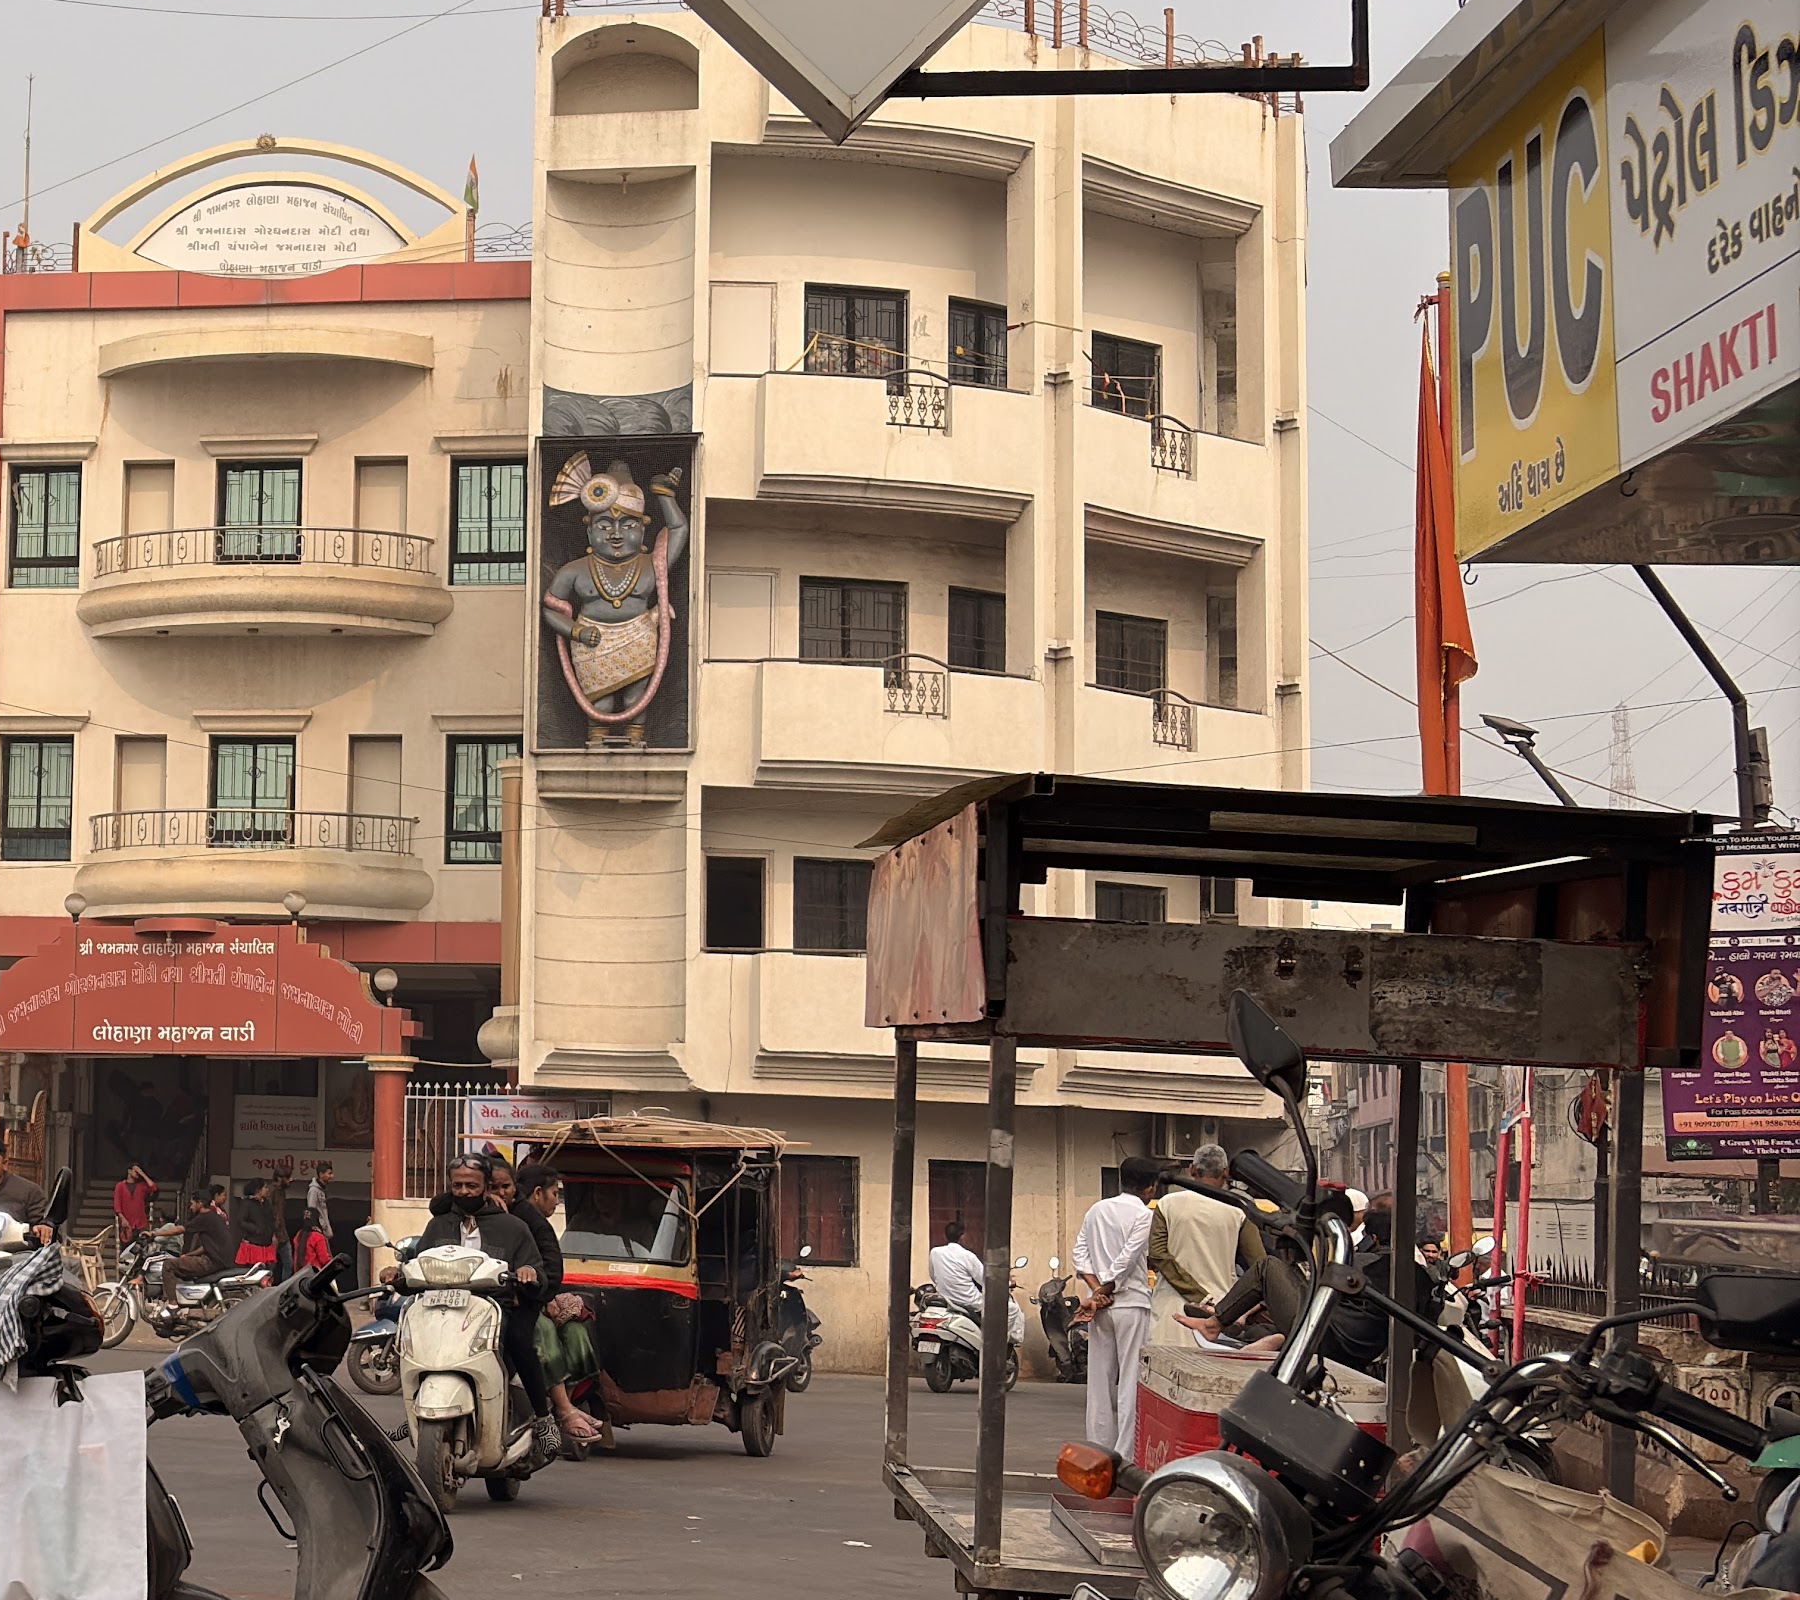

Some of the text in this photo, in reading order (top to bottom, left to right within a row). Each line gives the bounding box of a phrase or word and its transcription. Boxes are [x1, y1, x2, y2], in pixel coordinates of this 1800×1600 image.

[1621, 87, 1719, 249] પેટ્રોલ
[286, 196, 317, 210] મહાજન
[175, 226, 188, 236] શ્રી
[196, 227, 246, 236] જમનાદાસ
[318, 226, 342, 236] મોદી
[186, 241, 220, 251] શ્રીમતી
[276, 242, 326, 252] જમનાદાસ
[334, 241, 357, 252] મોદી
[1707, 218, 1743, 273] દરેક
[1455, 90, 1603, 460] PUC
[1649, 303, 1778, 423] SHAKTI
[1527, 457, 1550, 498] થાય
[1555, 436, 1565, 484] છે
[79, 938, 93, 955] શ્રી
[96, 943, 139, 955] જામનગર
[186, 943, 224, 956] મહાજન
[229, 938, 275, 955] સંચાલિત
[92, 1019, 256, 1044] લોહાણા મહાજન વાડી
[1695, 1093, 1721, 1105] Let's
[1723, 1093, 1748, 1106] Play
[1749, 1095, 1763, 1103] on
[1764, 1092, 1788, 1103] Live
[1697, 1387, 1731, 1401] 100
